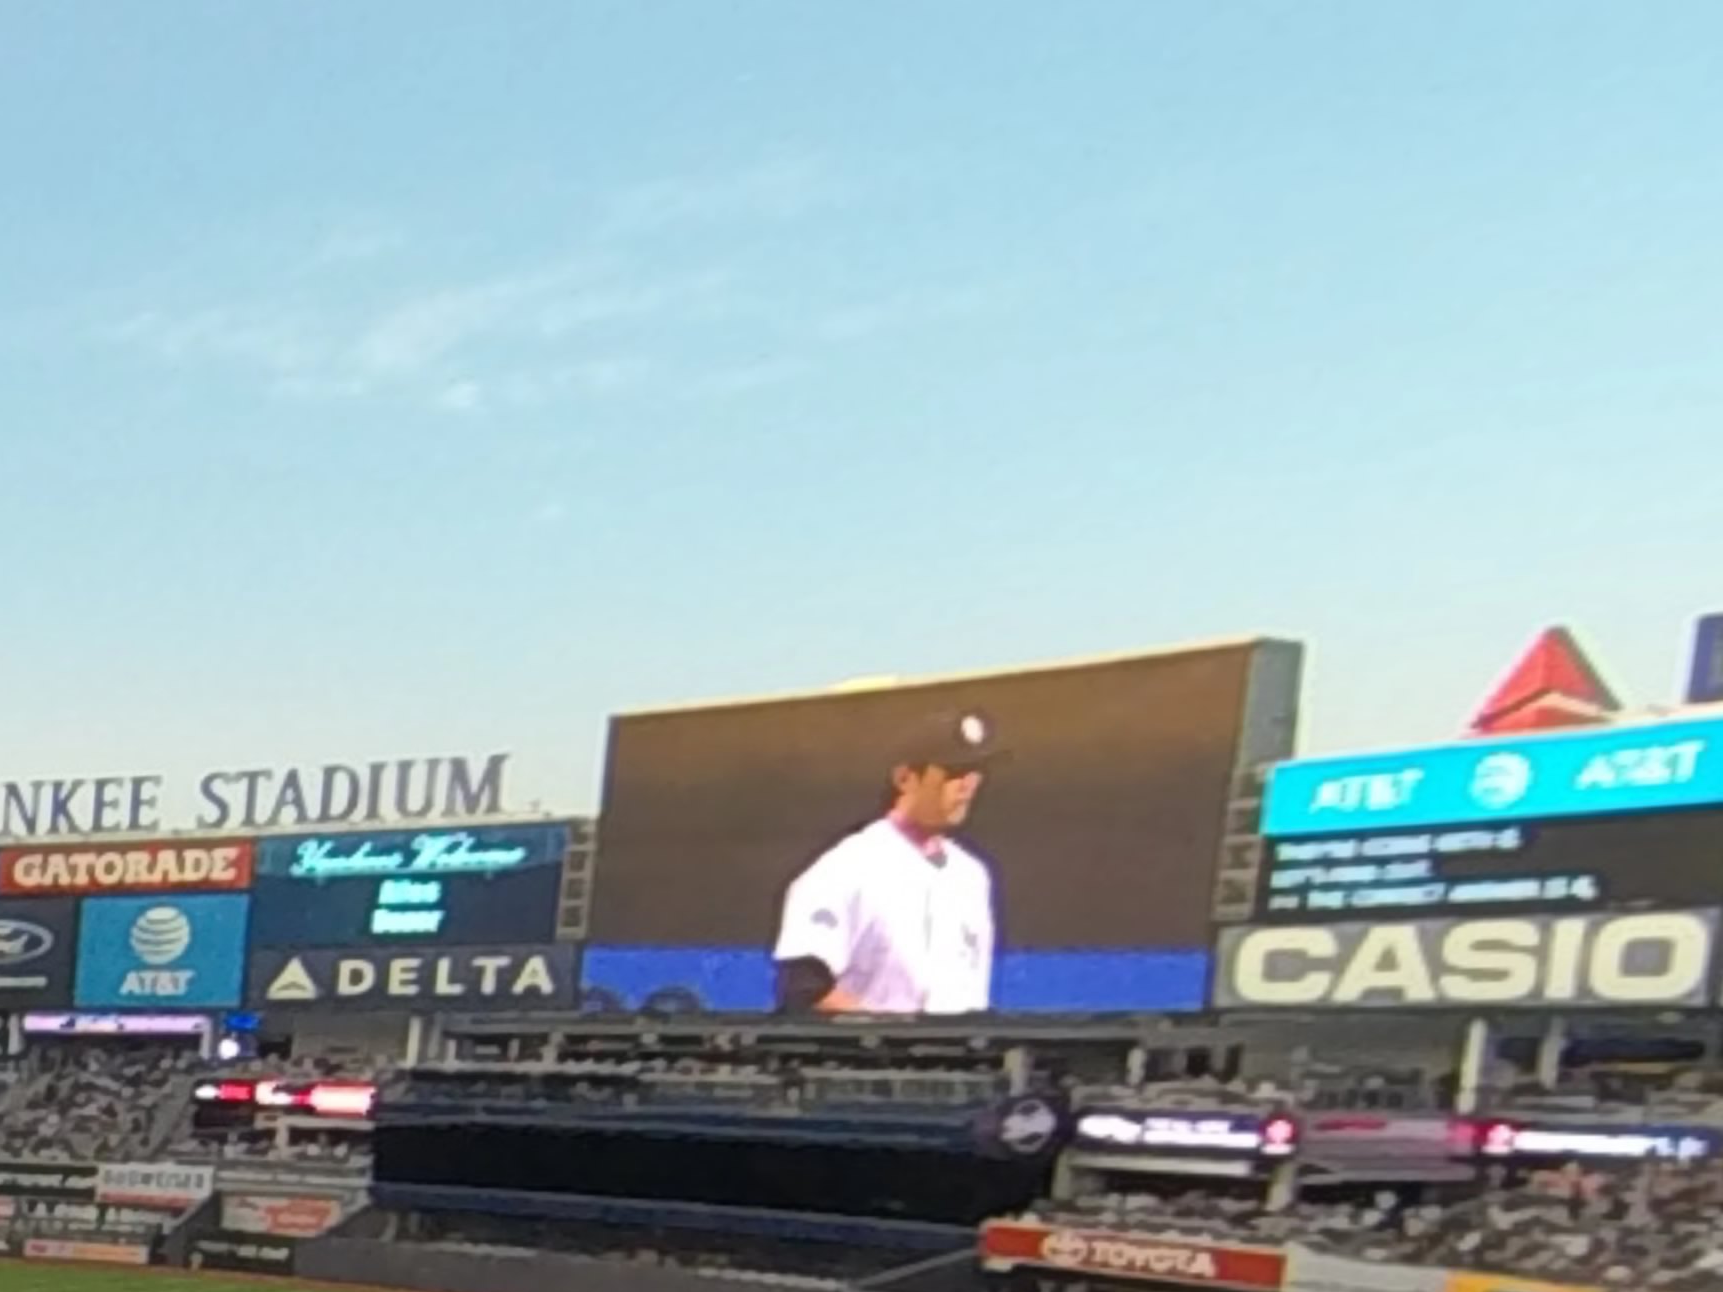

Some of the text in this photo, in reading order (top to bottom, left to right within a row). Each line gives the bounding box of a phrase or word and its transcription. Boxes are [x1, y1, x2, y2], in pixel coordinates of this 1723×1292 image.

[1574, 740, 1705, 790] AT&T
[196, 753, 510, 830] STADIUM
[12, 847, 242, 887] GATORADE
[336, 954, 555, 996] DELTA
[1234, 912, 1709, 1002] CASIO
[118, 968, 196, 996] AT&T
[1091, 1240, 1216, 1277] TOYOTA
